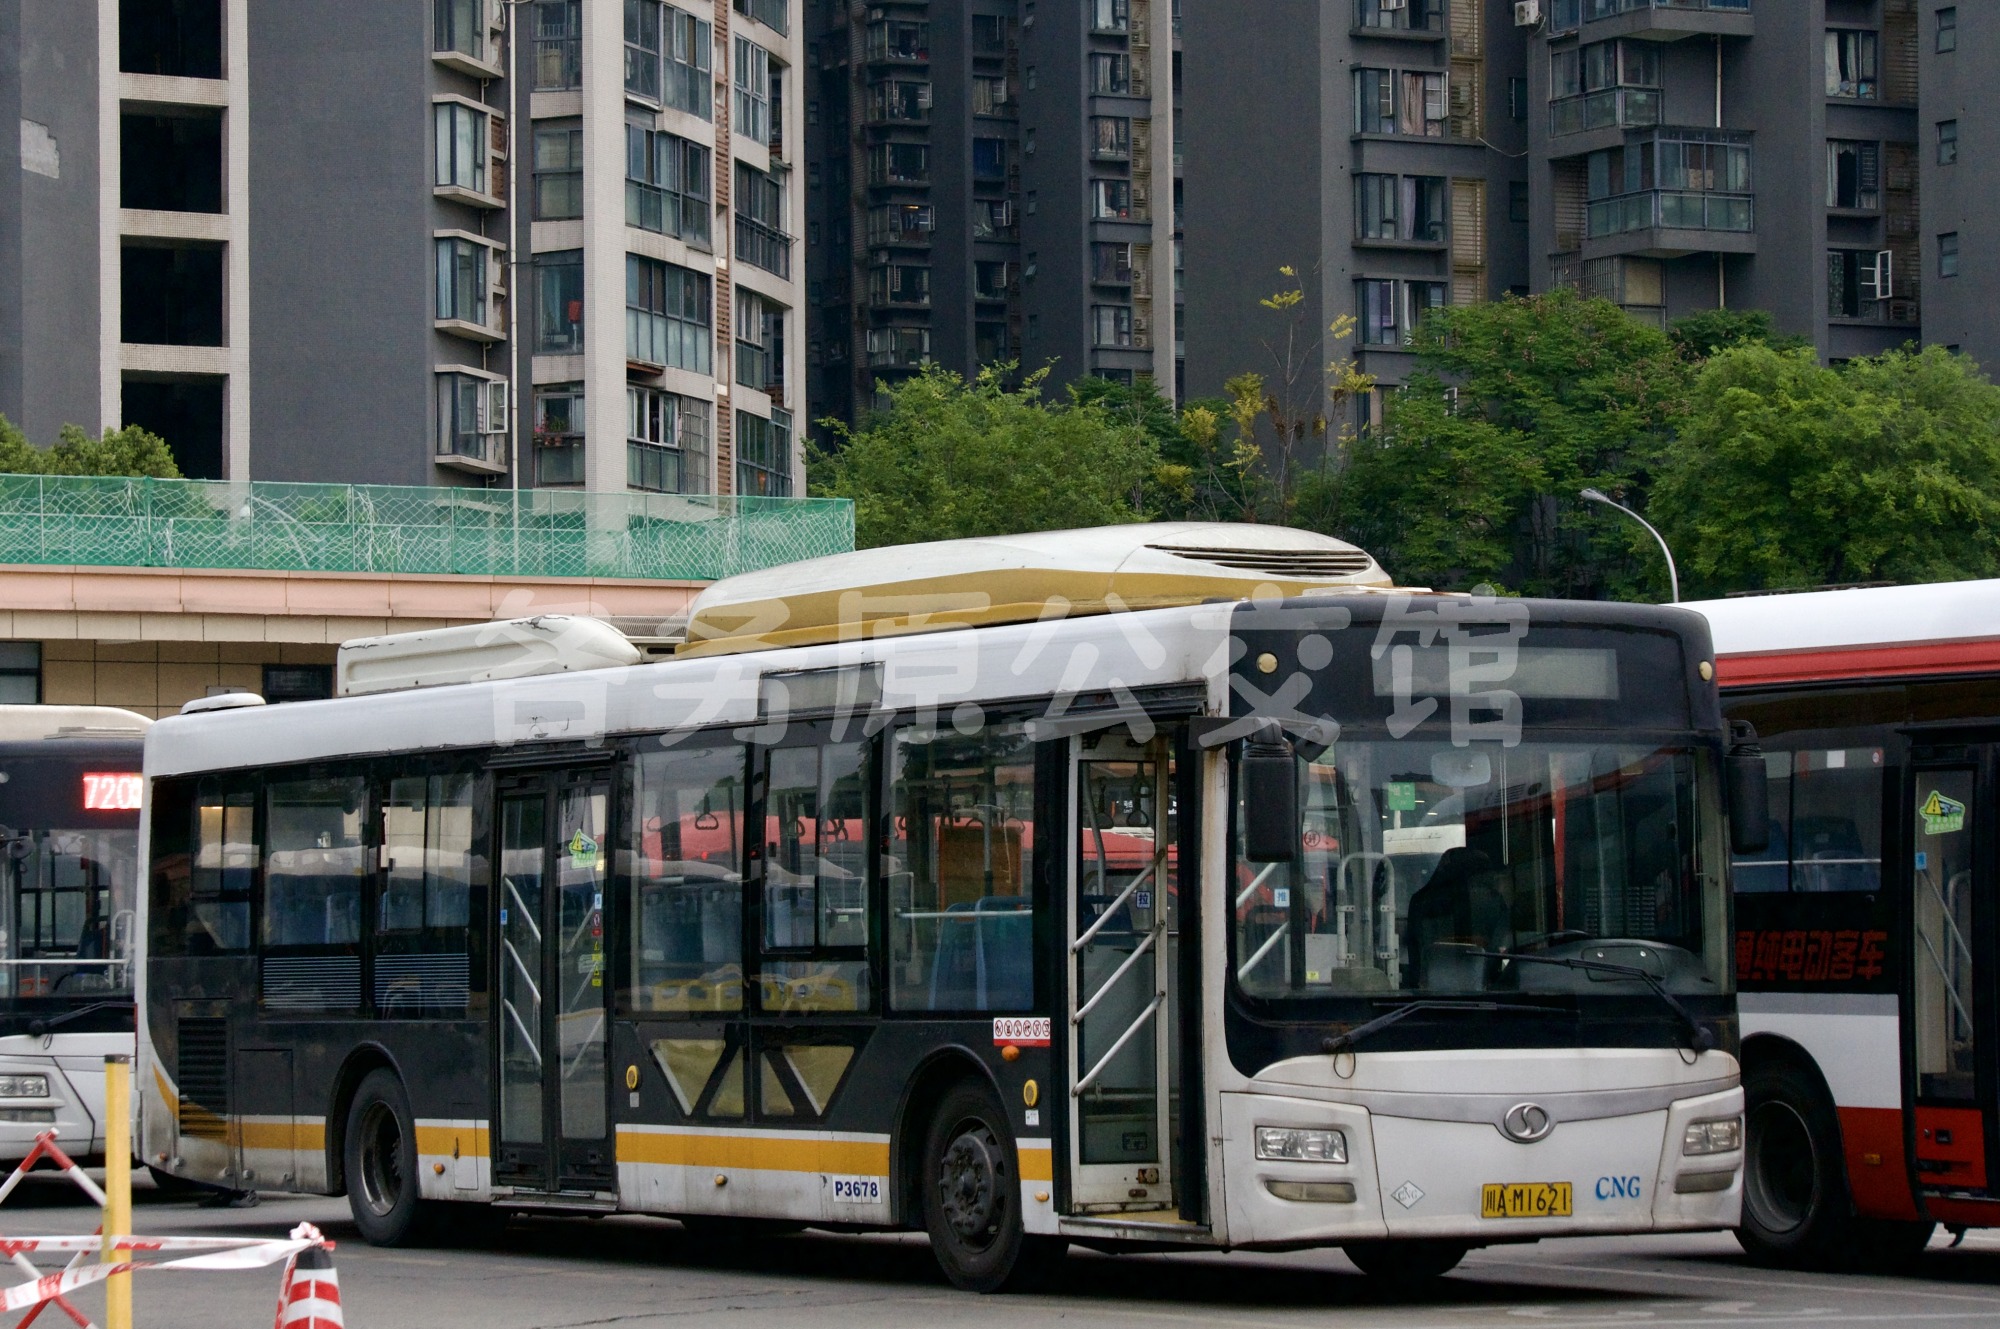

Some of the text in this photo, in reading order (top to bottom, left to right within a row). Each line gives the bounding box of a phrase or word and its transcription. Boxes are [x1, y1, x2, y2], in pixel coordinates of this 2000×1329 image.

[1139, 893, 1149, 904] 拉
[835, 1181, 878, 1197] P3678
[1396, 1186, 1418, 1201] CNG
[1595, 1176, 1640, 1200] CNG
